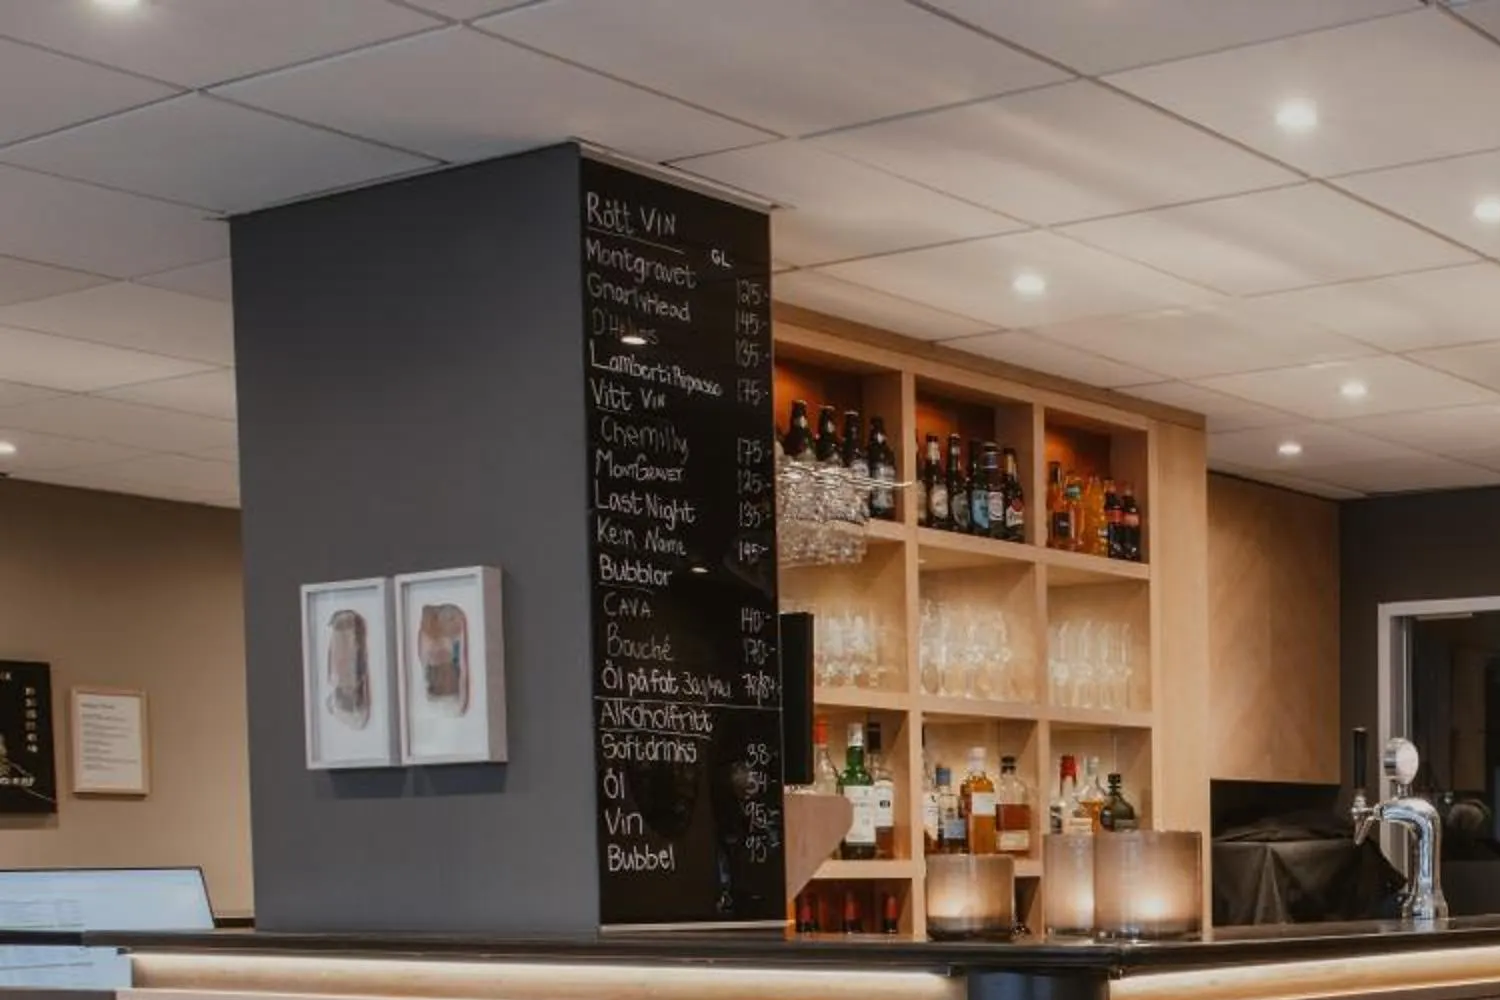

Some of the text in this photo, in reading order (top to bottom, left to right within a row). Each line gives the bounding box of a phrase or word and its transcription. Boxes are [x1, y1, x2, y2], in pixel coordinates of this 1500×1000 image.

[603, 767, 625, 800] Öl
[604, 806, 645, 836] Vin
[606, 842, 676, 873] Bubbel
